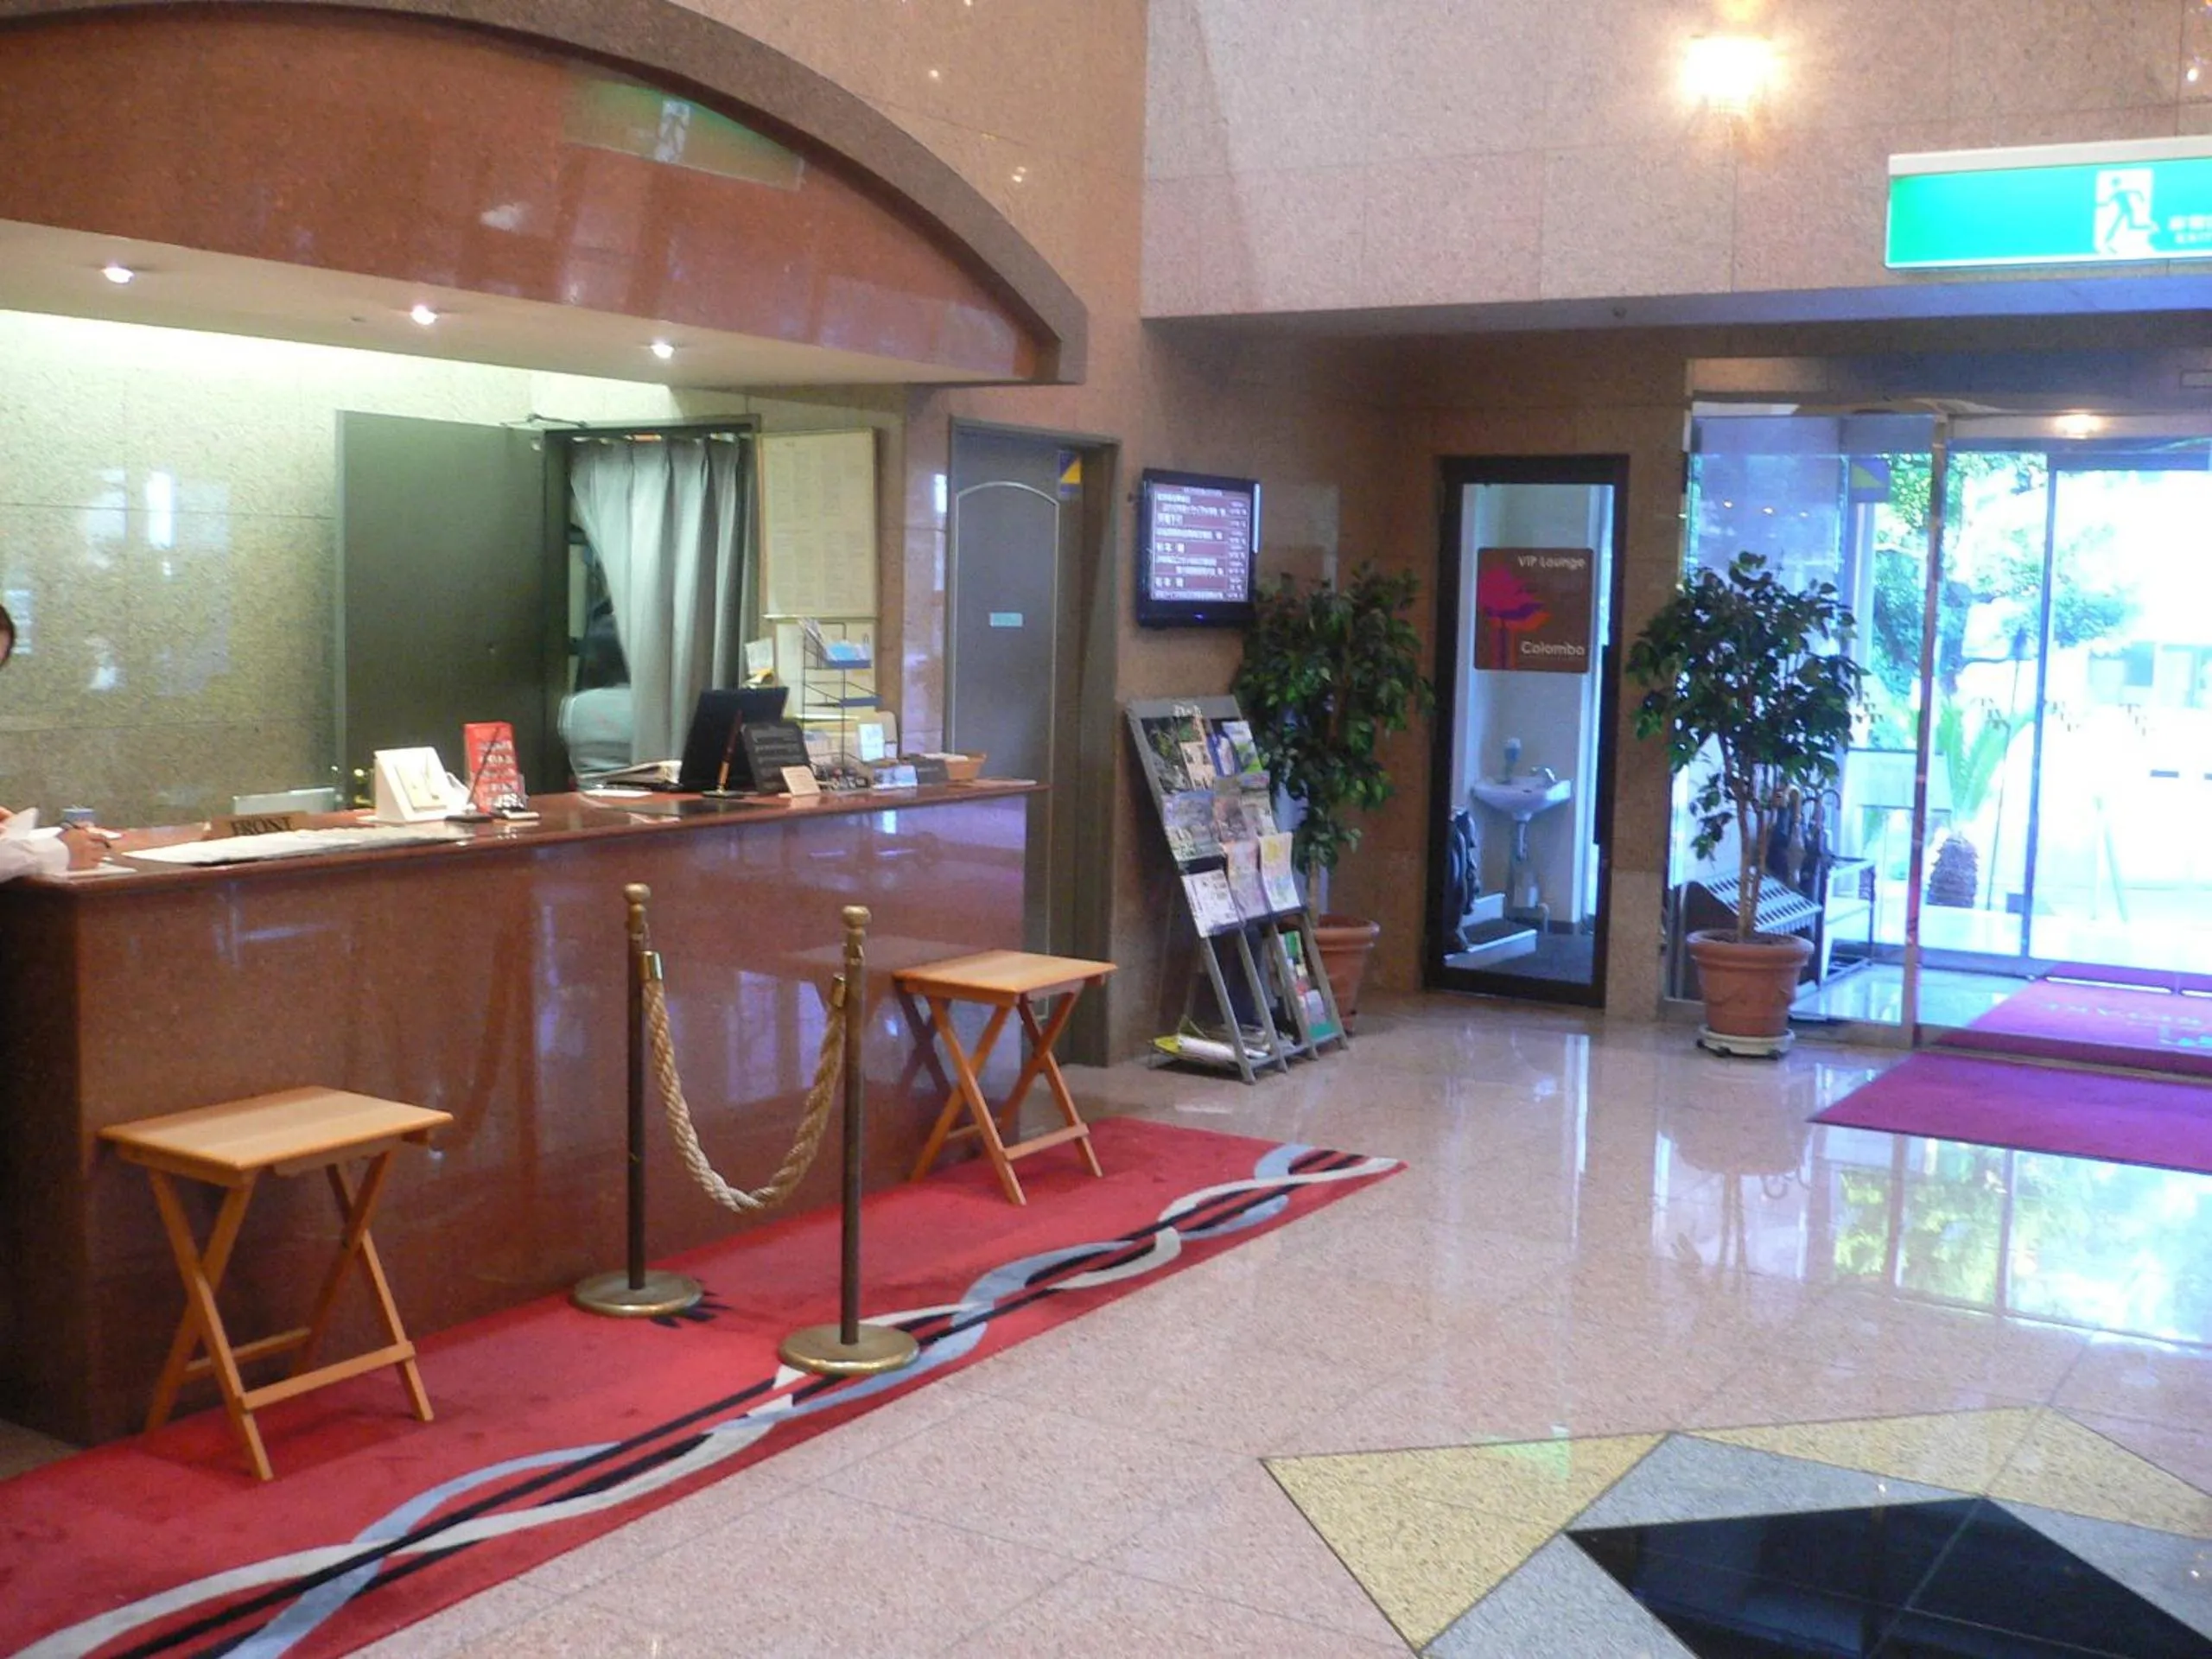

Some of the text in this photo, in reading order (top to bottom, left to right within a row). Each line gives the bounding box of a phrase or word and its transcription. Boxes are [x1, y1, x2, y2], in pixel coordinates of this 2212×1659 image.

[1518, 556, 1586, 570] VIP Lounge
[1521, 641, 1586, 656] Colombo
[230, 816, 291, 836] FRONT
